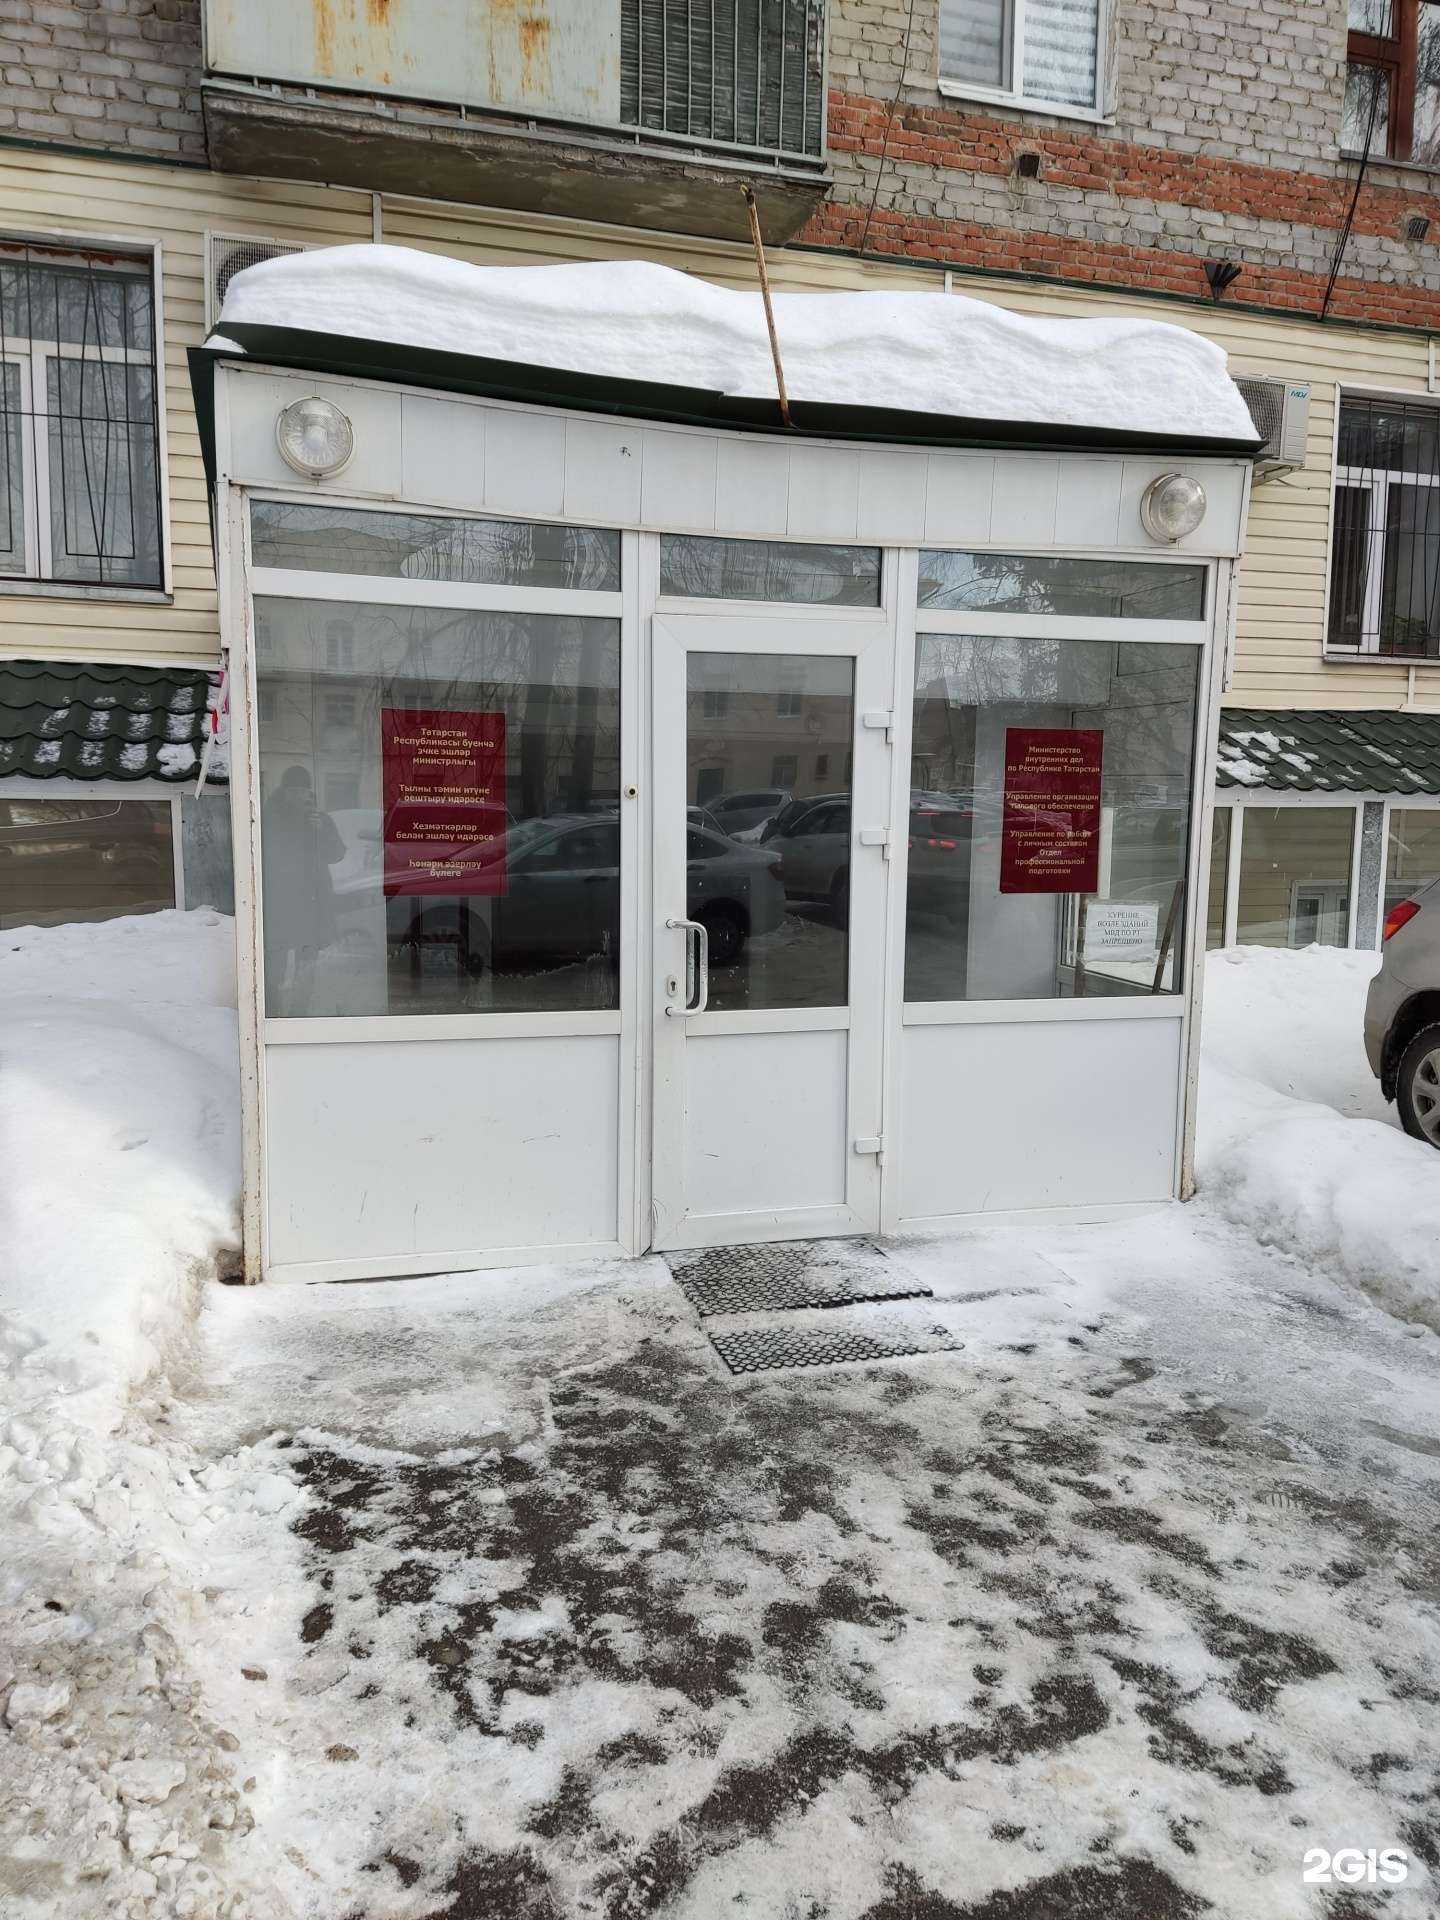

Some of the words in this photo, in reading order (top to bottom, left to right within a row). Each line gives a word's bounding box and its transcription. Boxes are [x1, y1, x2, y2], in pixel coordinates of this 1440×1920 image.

[421, 728, 467, 738] Татарстан
[393, 736, 460, 747] Республикасы
[462, 738, 495, 748] буенча
[1028, 746, 1081, 754] Министерство
[412, 757, 476, 766] министрлыгы
[1063, 765, 1100, 774] Татарстан
[1006, 792, 1051, 802] Управление
